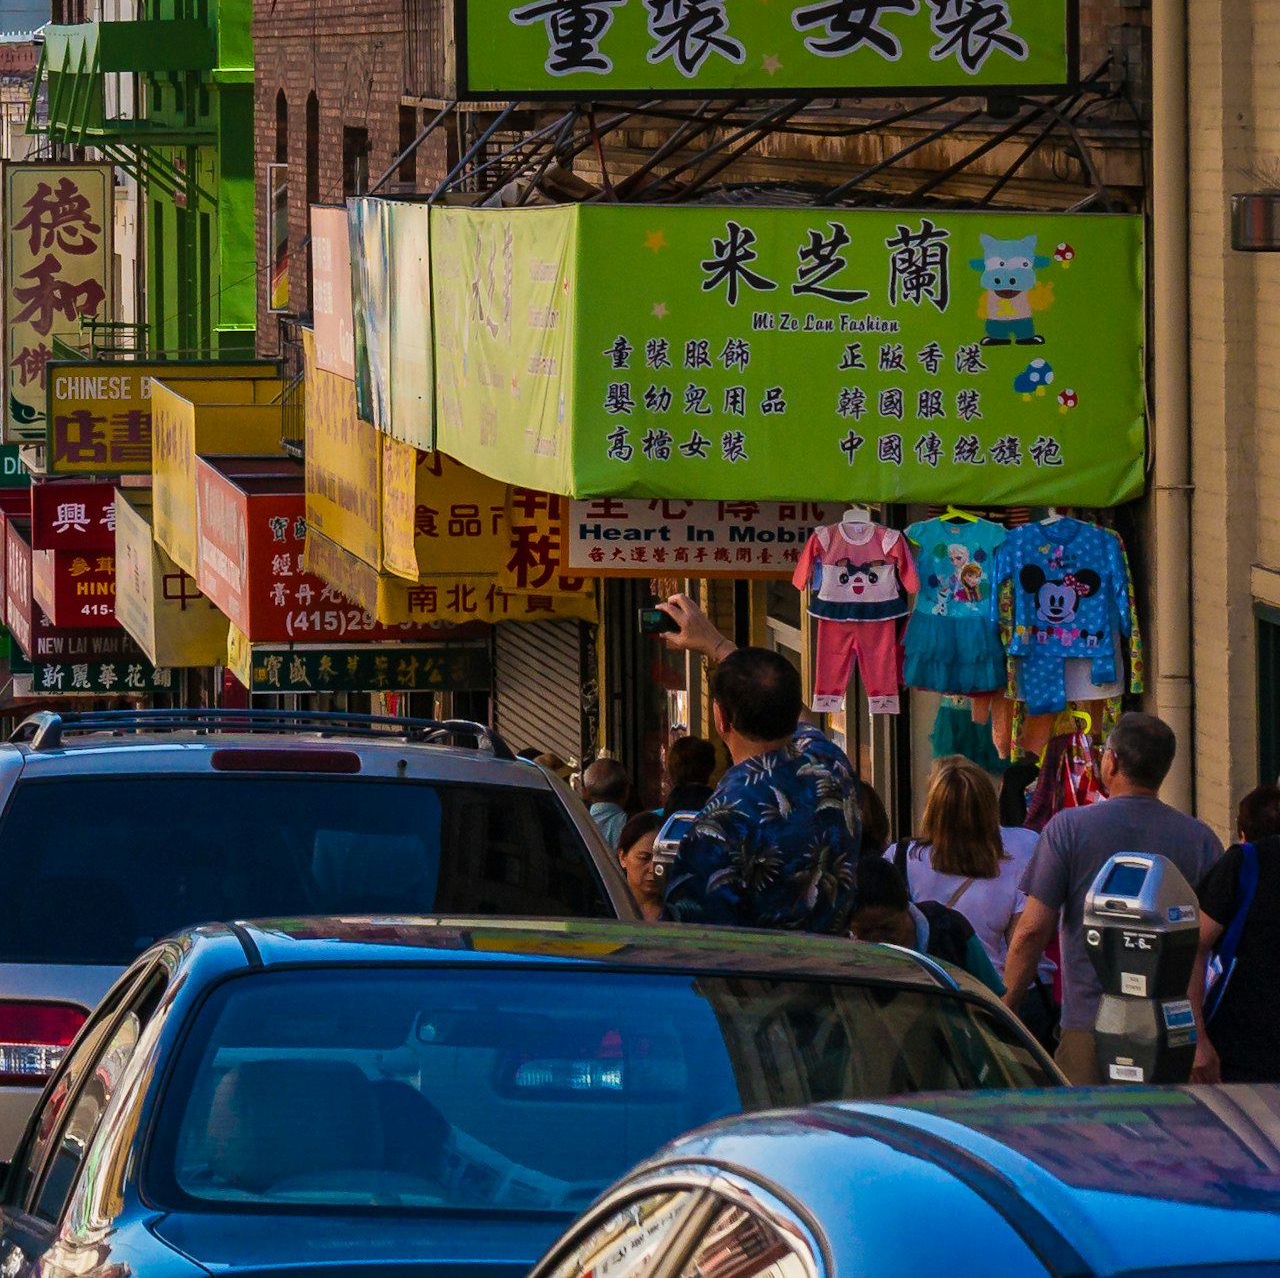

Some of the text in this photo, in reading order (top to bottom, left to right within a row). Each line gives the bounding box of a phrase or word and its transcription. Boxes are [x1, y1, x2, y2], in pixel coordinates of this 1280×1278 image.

[700, 219, 952, 313] 米芝蘭
[752, 313, 901, 334] Mi Ze Lan Fashion
[603, 335, 752, 371] 童裝服飾
[837, 342, 988, 375] 正版香港
[55, 376, 132, 400] CHINESE
[836, 387, 985, 421] 韓國服裝
[605, 426, 748, 463] 高檔女裝
[839, 430, 1065, 468] 中國傳統旗袍
[579, 524, 671, 541] Heart
[686, 526, 715, 542] In
[37, 637, 119, 655] NEW LAI WAH
